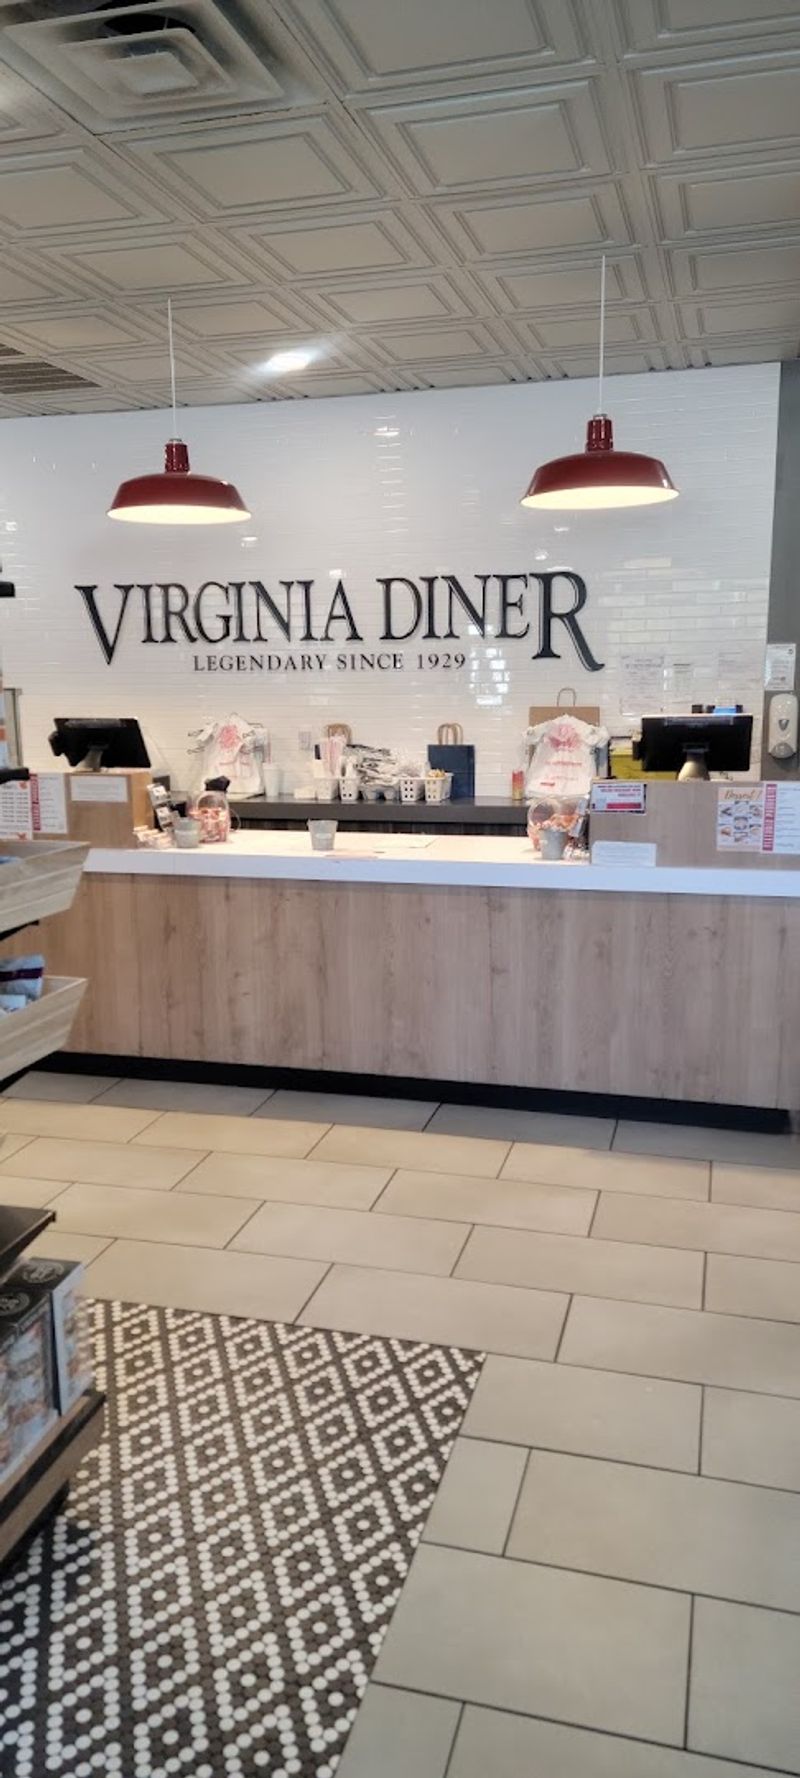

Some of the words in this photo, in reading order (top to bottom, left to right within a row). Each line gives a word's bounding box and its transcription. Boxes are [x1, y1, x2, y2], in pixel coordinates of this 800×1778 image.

[74, 579, 363, 666] VIRGINIA
[375, 571, 605, 672] DINER
[193, 654, 327, 672] LEGENDARY
[336, 653, 404, 670] SINCE
[416, 653, 466, 669] 1929
